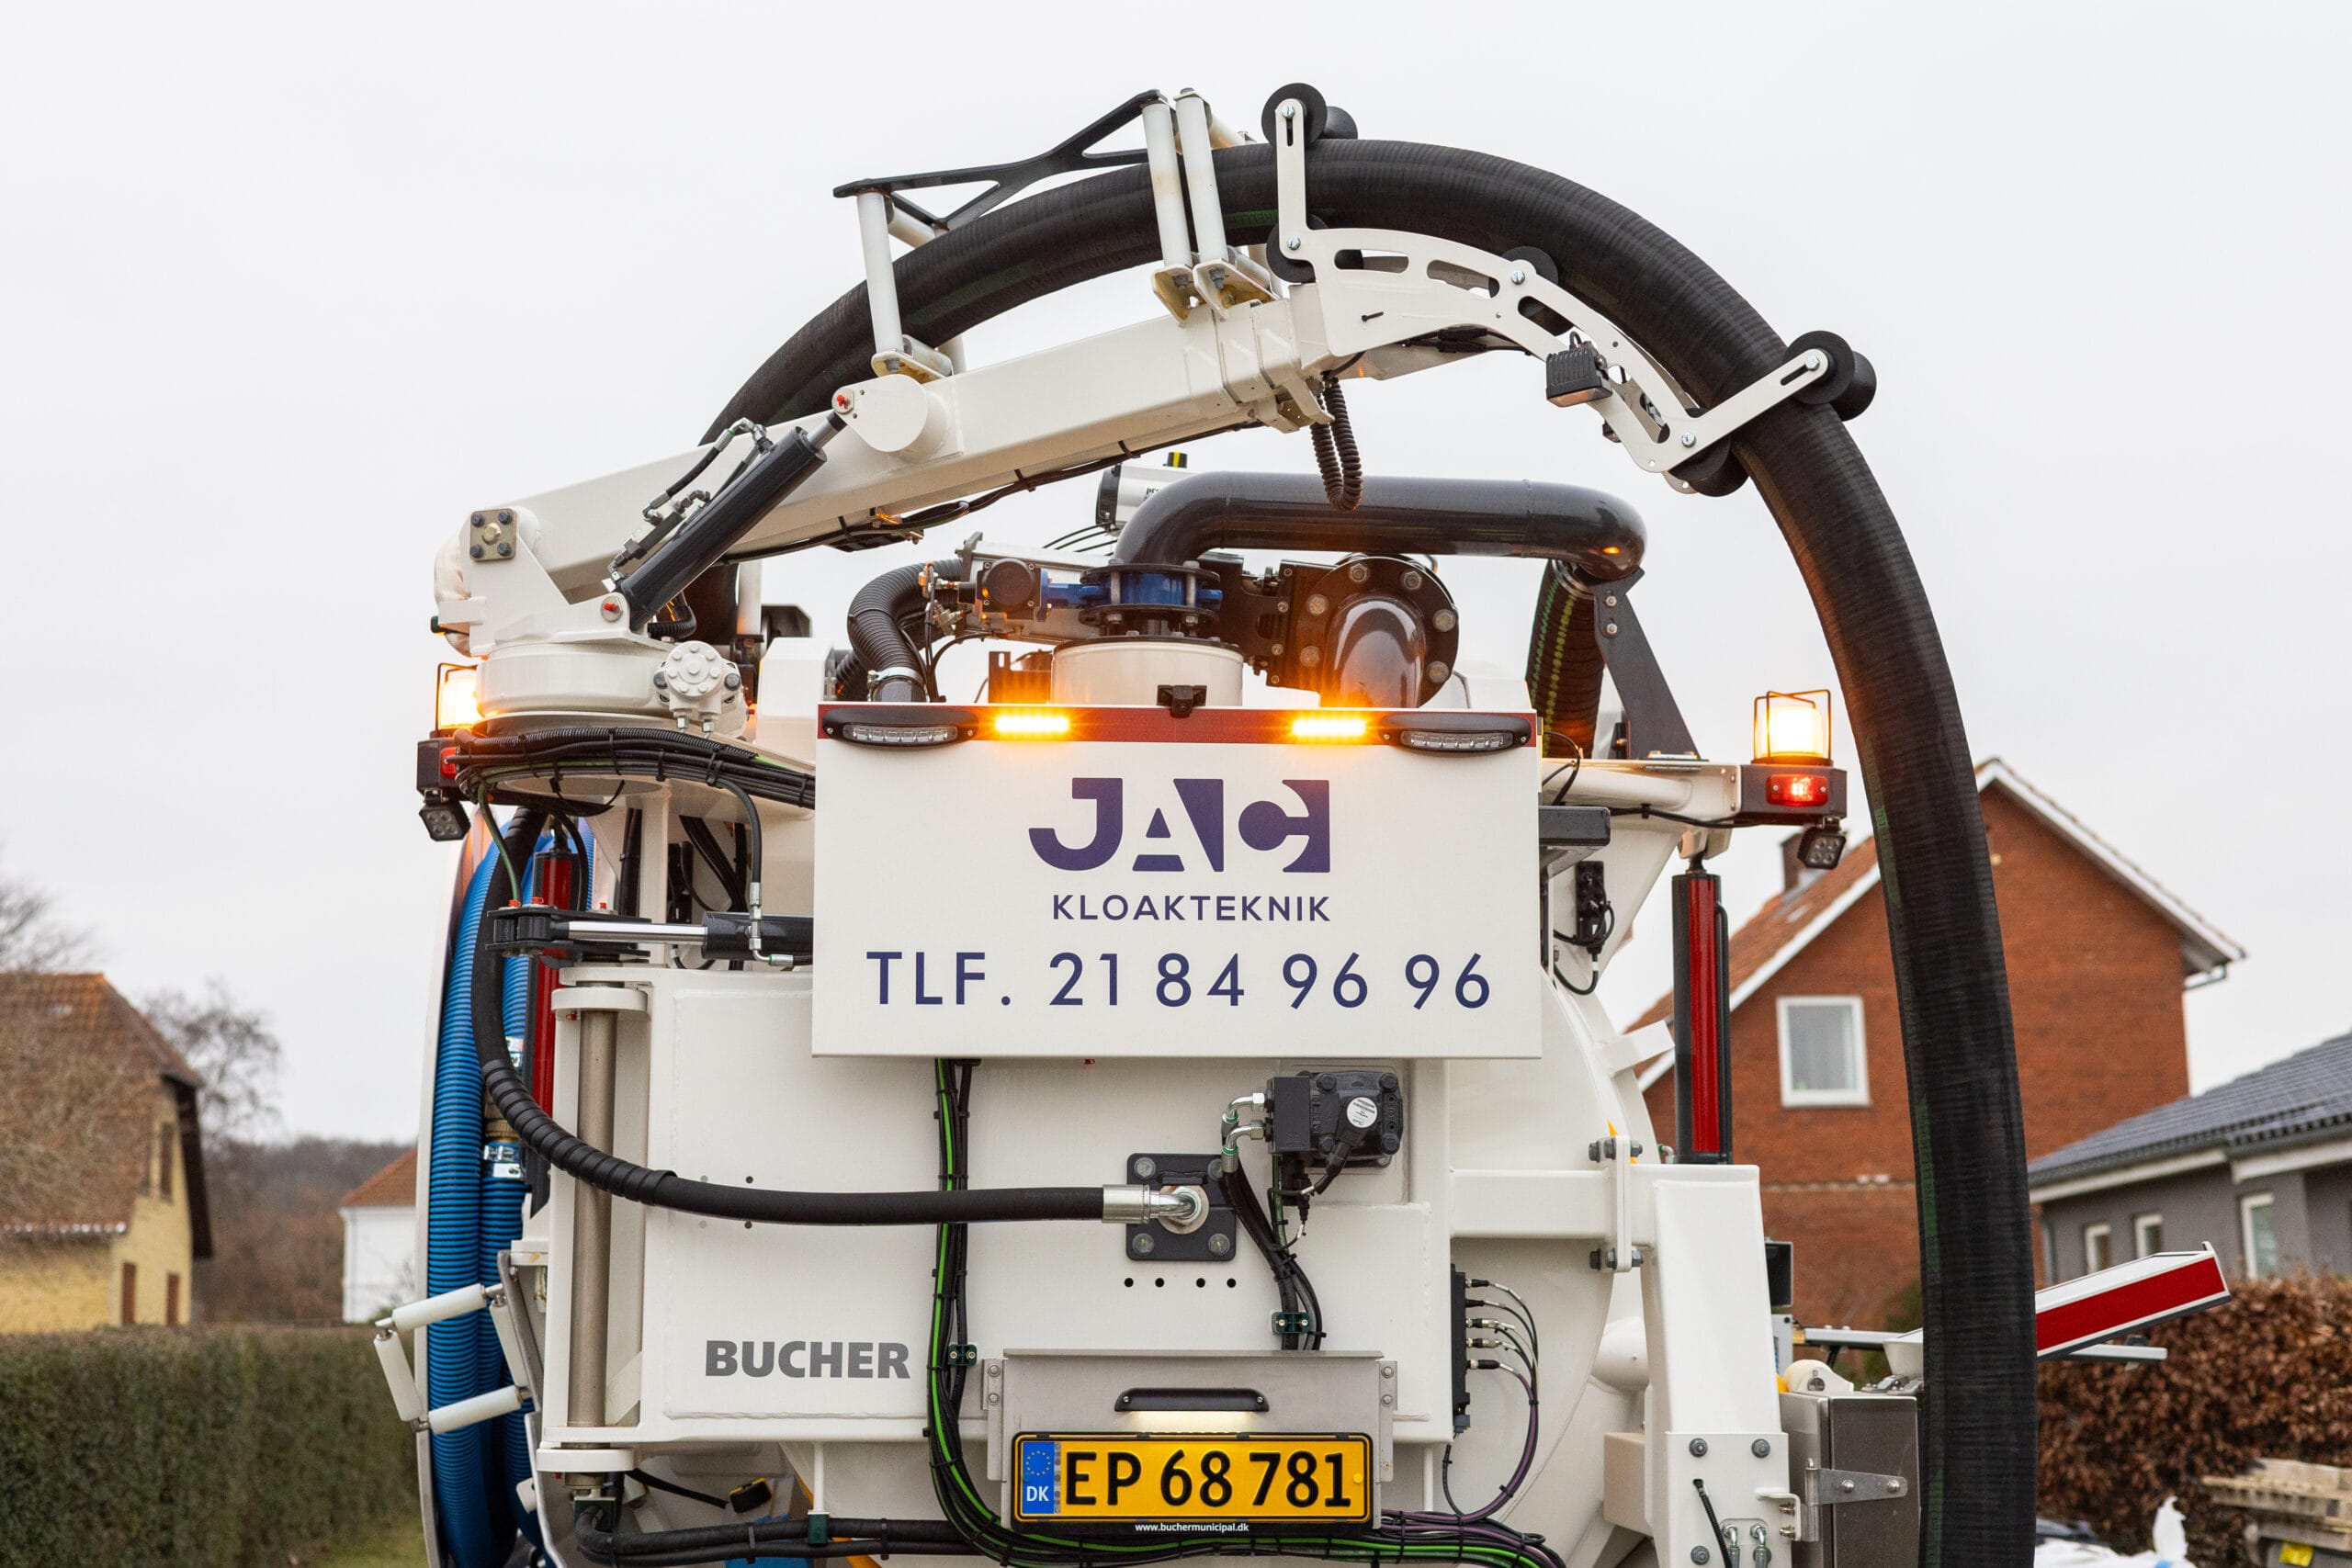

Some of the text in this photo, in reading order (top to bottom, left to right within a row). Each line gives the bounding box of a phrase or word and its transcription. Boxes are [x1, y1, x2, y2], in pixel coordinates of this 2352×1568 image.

[1029, 778, 1330, 872] JAC
[1054, 895, 1330, 921] KLOAKTEKNIK
[866, 951, 1490, 1010] TLF. 21 84 96 96
[706, 1340, 911, 1379] BUCHER
[1026, 1486, 1049, 1502] DK
[1066, 1450, 1351, 1507] EP 68 781
[1135, 1522, 1250, 1533] www.buchermunicipal.dk
